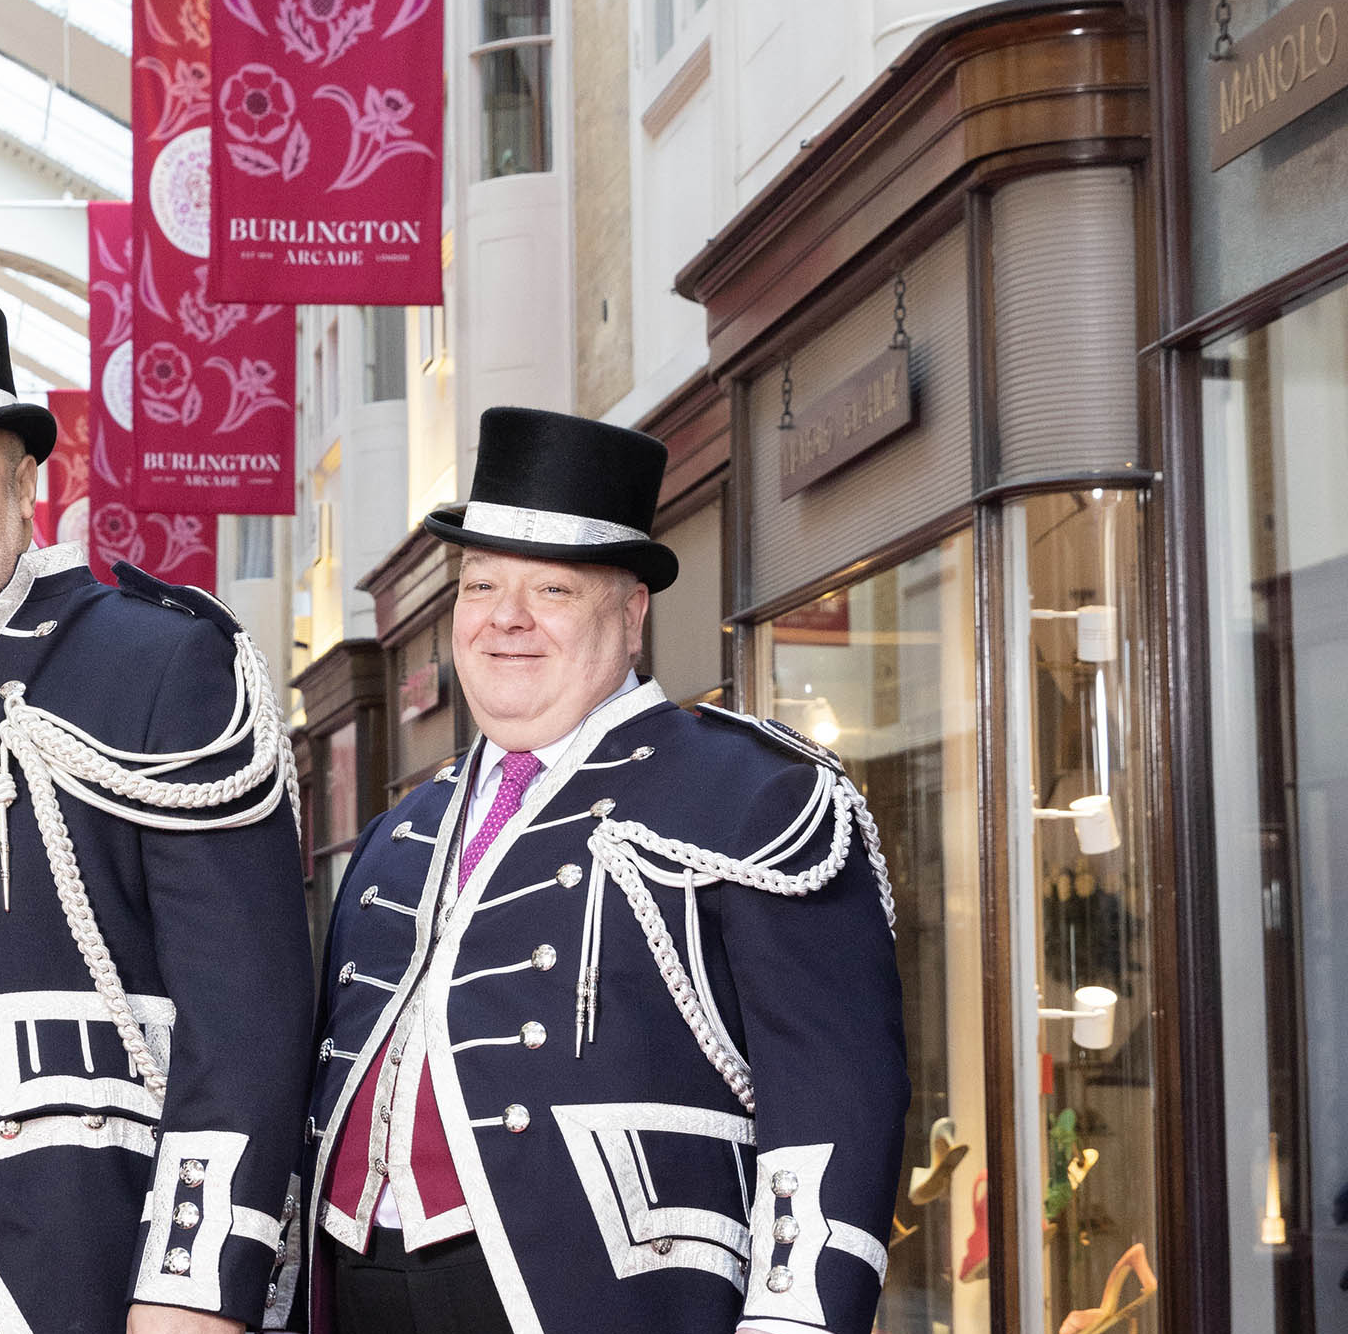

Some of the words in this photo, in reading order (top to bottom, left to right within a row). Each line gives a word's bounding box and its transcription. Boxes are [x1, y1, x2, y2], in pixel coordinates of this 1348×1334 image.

[1219, 6, 1338, 135] MANOLO
[229, 218, 421, 244] BURLINGTON
[283, 248, 364, 266] ARCADE
[143, 452, 281, 472] BURLINGTON
[183, 474, 240, 487] ARCADE
